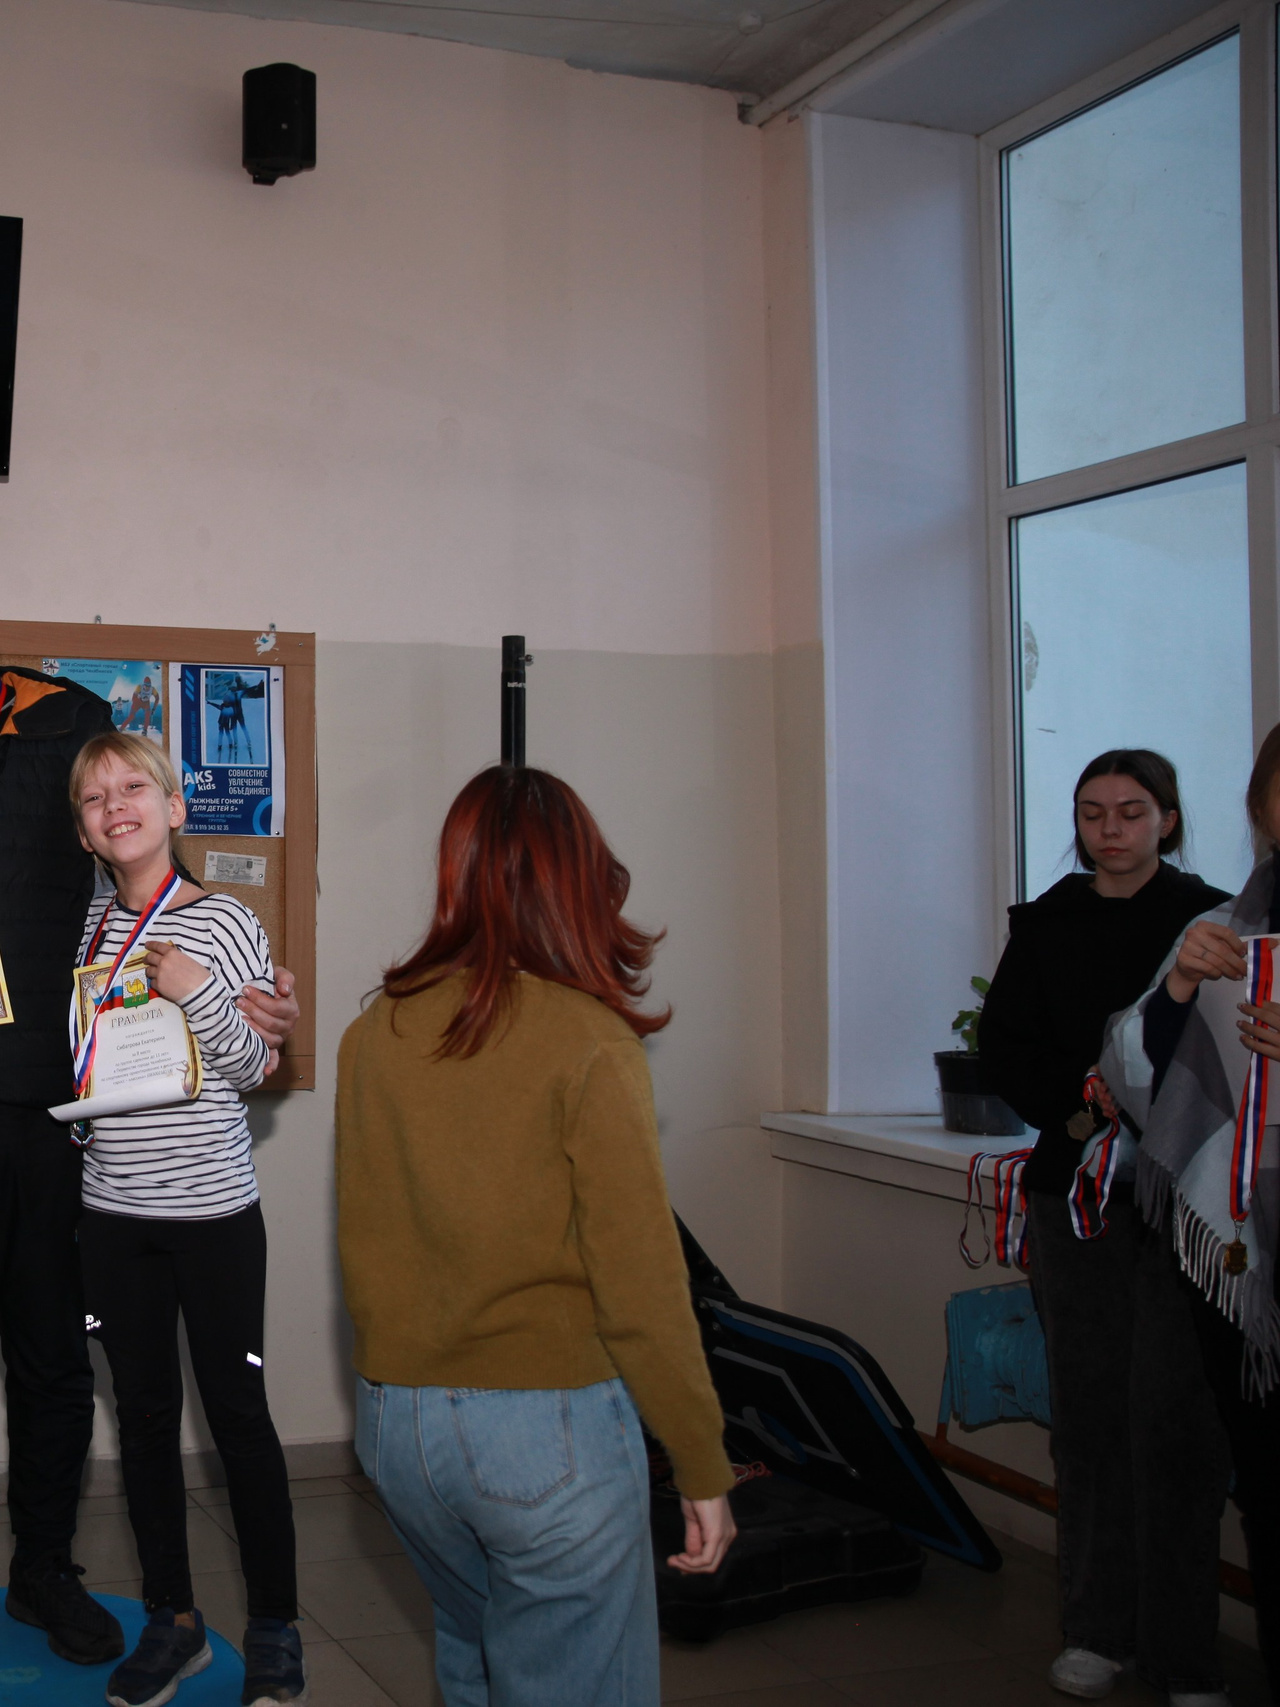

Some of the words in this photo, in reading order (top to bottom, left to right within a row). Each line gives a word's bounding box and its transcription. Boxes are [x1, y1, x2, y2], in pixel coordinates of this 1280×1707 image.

[184, 769, 214, 786] AKS
[228, 769, 268, 778] СОВМЕСТНОЕ
[197, 782, 216, 792] kids
[228, 778, 263, 787] УВЛЕЧЕНИЕ
[228, 787, 270, 796] ОБЪЕДИНЯЕТ!
[111, 1008, 164, 1028] ГРАМОТА
[116, 1041, 140, 1051] Сибатрова
[141, 1035, 165, 1045] Екатерина
